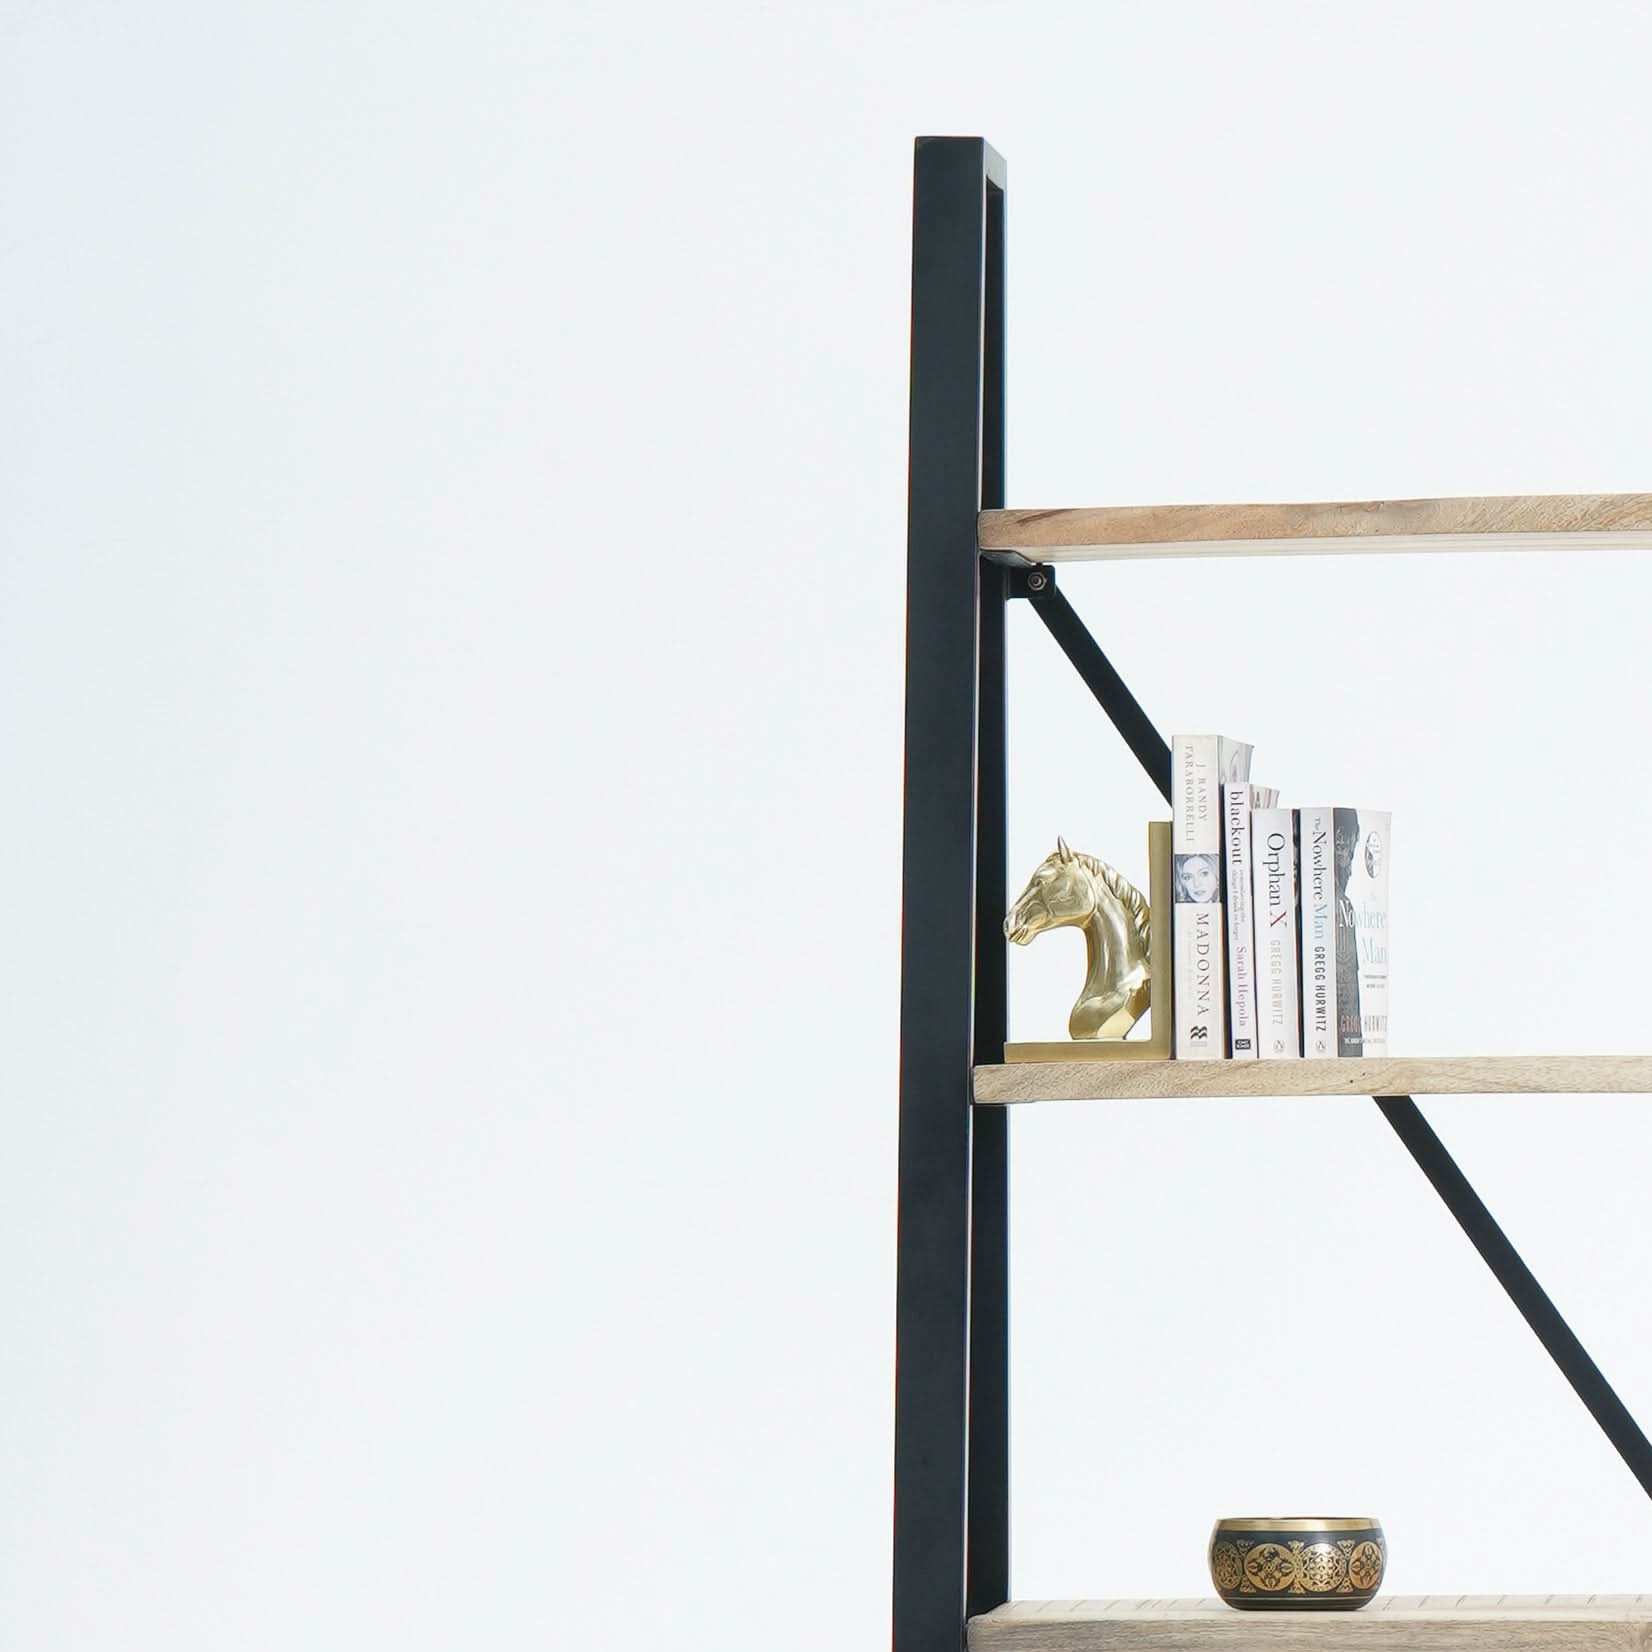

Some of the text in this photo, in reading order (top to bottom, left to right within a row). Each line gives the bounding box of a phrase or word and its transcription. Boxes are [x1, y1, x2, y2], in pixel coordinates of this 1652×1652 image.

[1184, 745, 1195, 841] TARABORRELLI
[1198, 778, 1208, 821] RANDY
[1230, 791, 1245, 864] blackout
[1262, 833, 1287, 927] Orphan X
[1312, 832, 1327, 900] Nowhere
[1314, 904, 1328, 939] Man
[1339, 901, 1386, 928] Nowhere
[1197, 913, 1210, 1017] MADONNA
[1236, 946, 1247, 979] Sarah
[1270, 940, 1283, 1024] GREGG HURWITZ
[1362, 936, 1387, 964] Man
[1235, 984, 1249, 1026] Hepola
[1314, 946, 1327, 1031] GREGG HURWITZ
